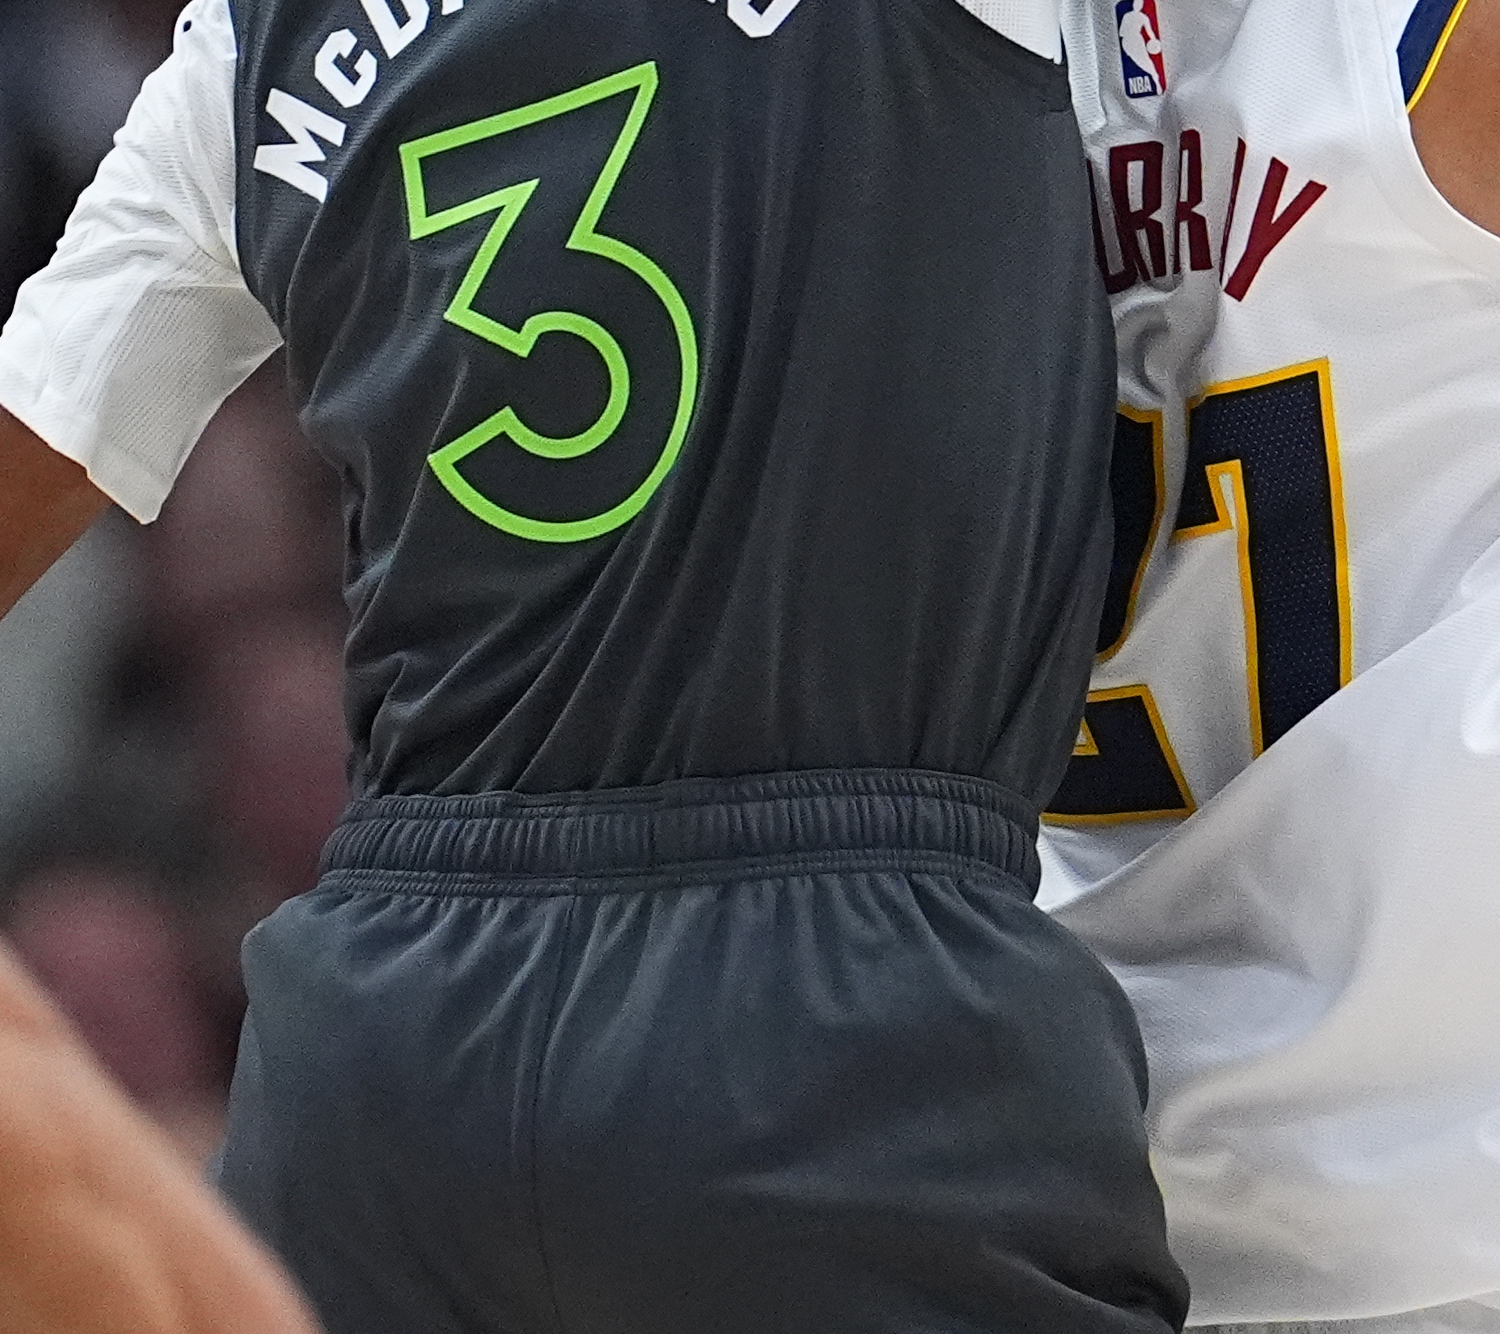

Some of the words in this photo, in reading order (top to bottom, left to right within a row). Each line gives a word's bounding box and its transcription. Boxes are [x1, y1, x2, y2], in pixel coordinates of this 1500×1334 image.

[1128, 75, 1152, 95] NBA
[398, 60, 699, 544] 3
[1086, 128, 1328, 303] URRY
